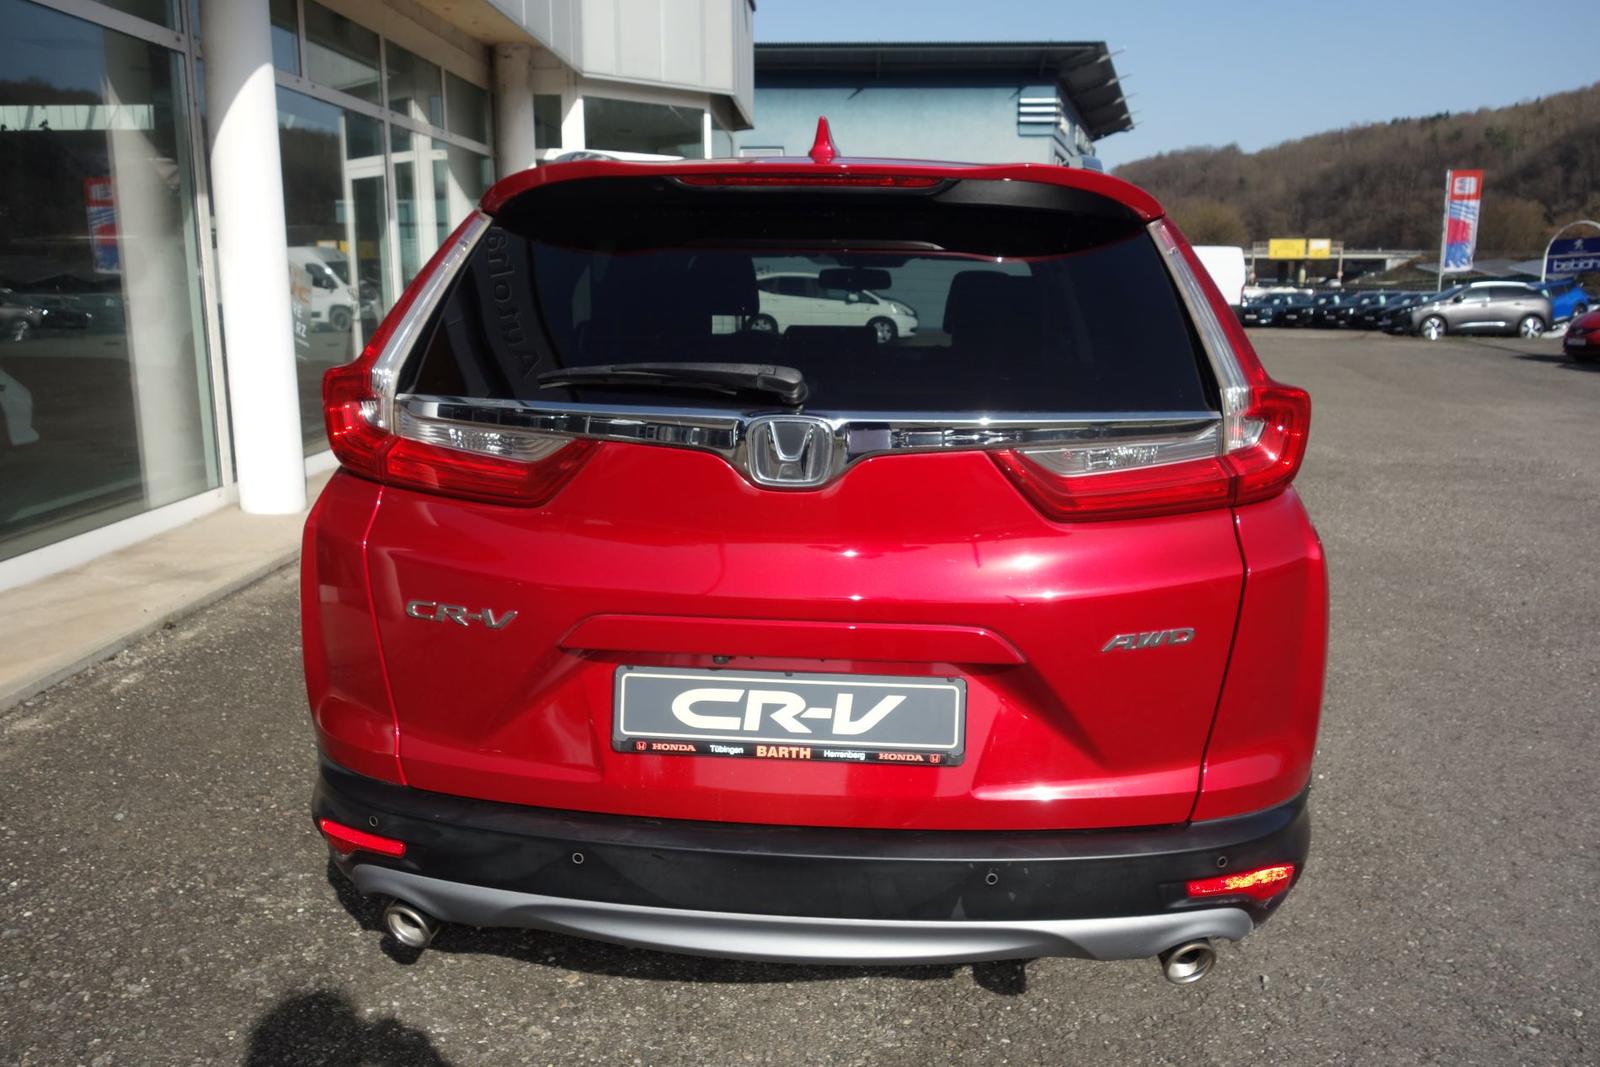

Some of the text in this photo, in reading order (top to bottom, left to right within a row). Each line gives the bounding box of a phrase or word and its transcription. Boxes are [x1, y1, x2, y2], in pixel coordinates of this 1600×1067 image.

[406, 600, 519, 629] CR-V
[1101, 627, 1195, 652] AWD
[671, 688, 907, 735] CR-V
[652, 743, 697, 752] HONDA
[709, 744, 744, 755] Tübingen
[756, 745, 811, 759] BARTH
[823, 750, 866, 761] Herrenberg
[878, 752, 924, 762] HONDA
